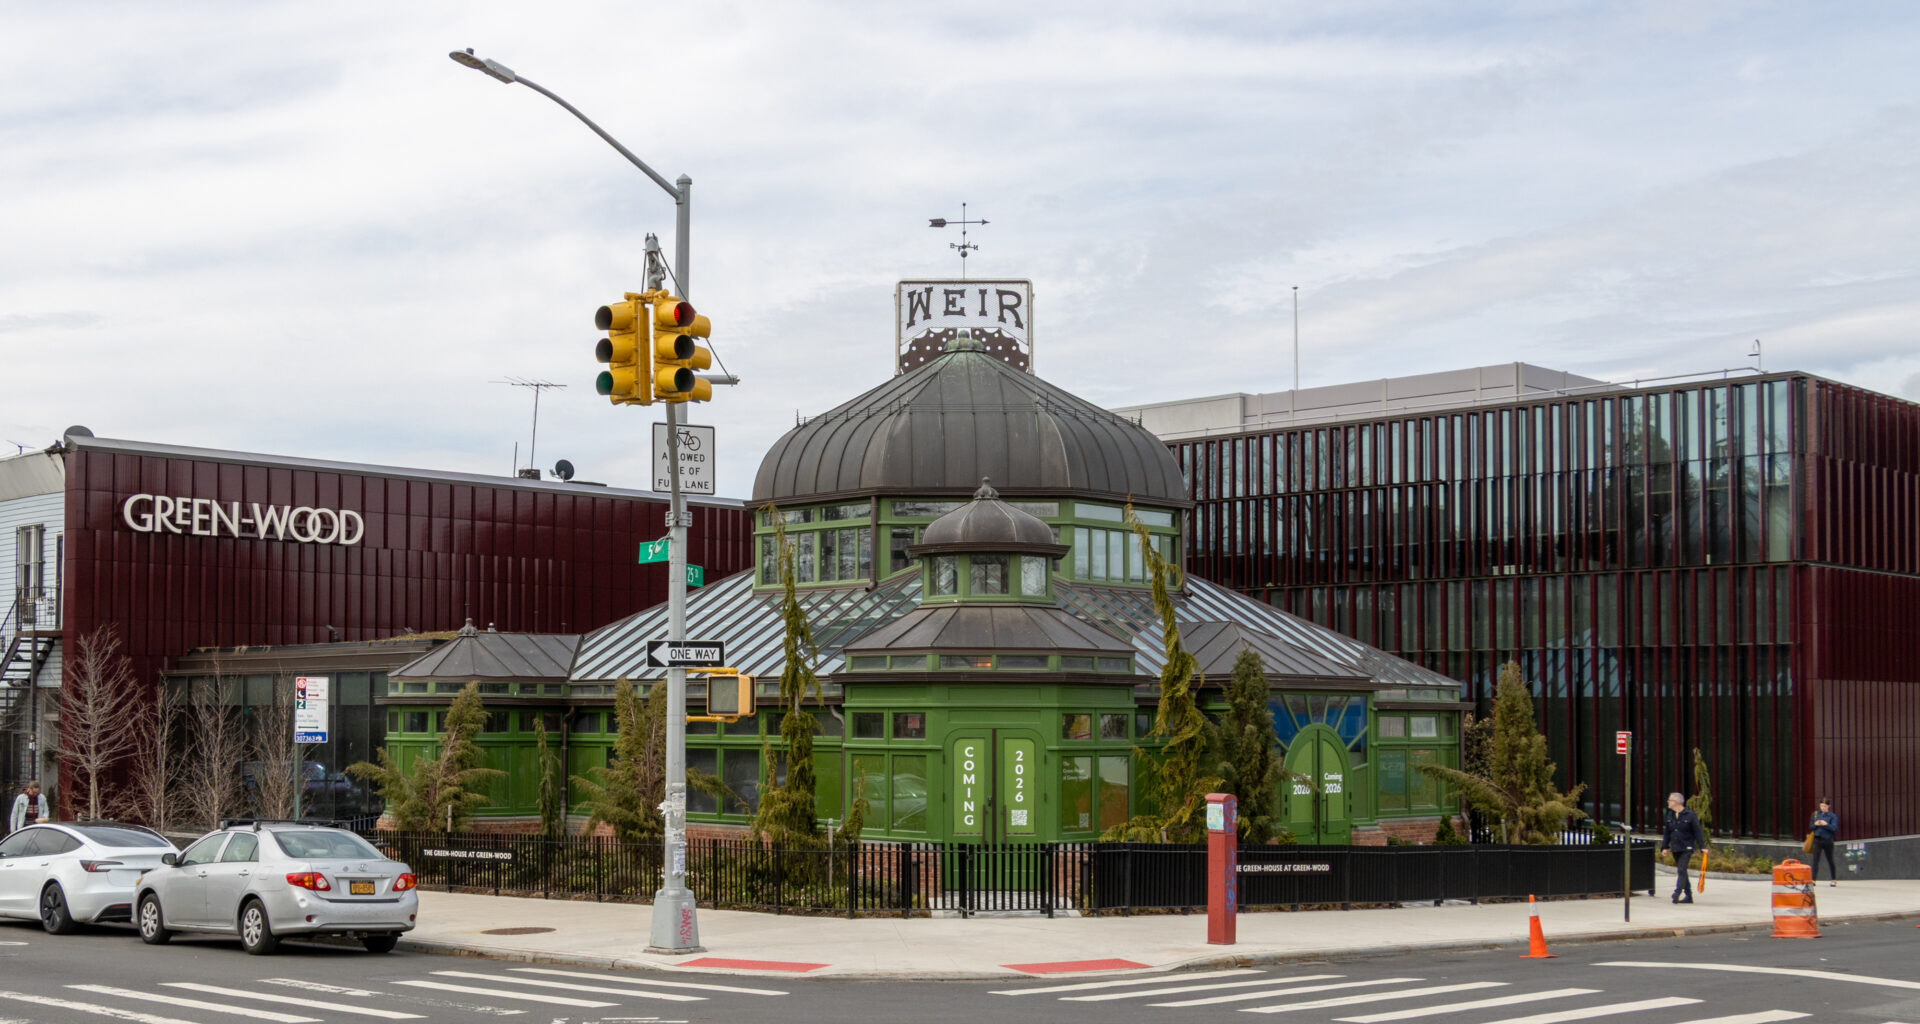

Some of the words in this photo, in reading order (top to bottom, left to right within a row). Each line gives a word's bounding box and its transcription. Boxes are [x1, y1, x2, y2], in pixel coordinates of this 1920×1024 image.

[906, 286, 1024, 330] WEIR
[662, 452, 706, 463] AOWED
[688, 467, 701, 476] OF
[685, 481, 709, 494] LANE
[123, 493, 365, 545] GREEN-WOOD
[670, 648, 691, 660] ONE
[695, 648, 717, 660] WAY
[1015, 750, 1024, 803] 2026
[963, 746, 975, 825] COMING
[1325, 783, 1342, 793] 2026
[476, 851, 512, 859] GREEN-WOOD
[1243, 864, 1283, 872] GREEN-HOUSE
[1284, 864, 1292, 872] AT
[1293, 864, 1330, 872] GREEN-WOOD
